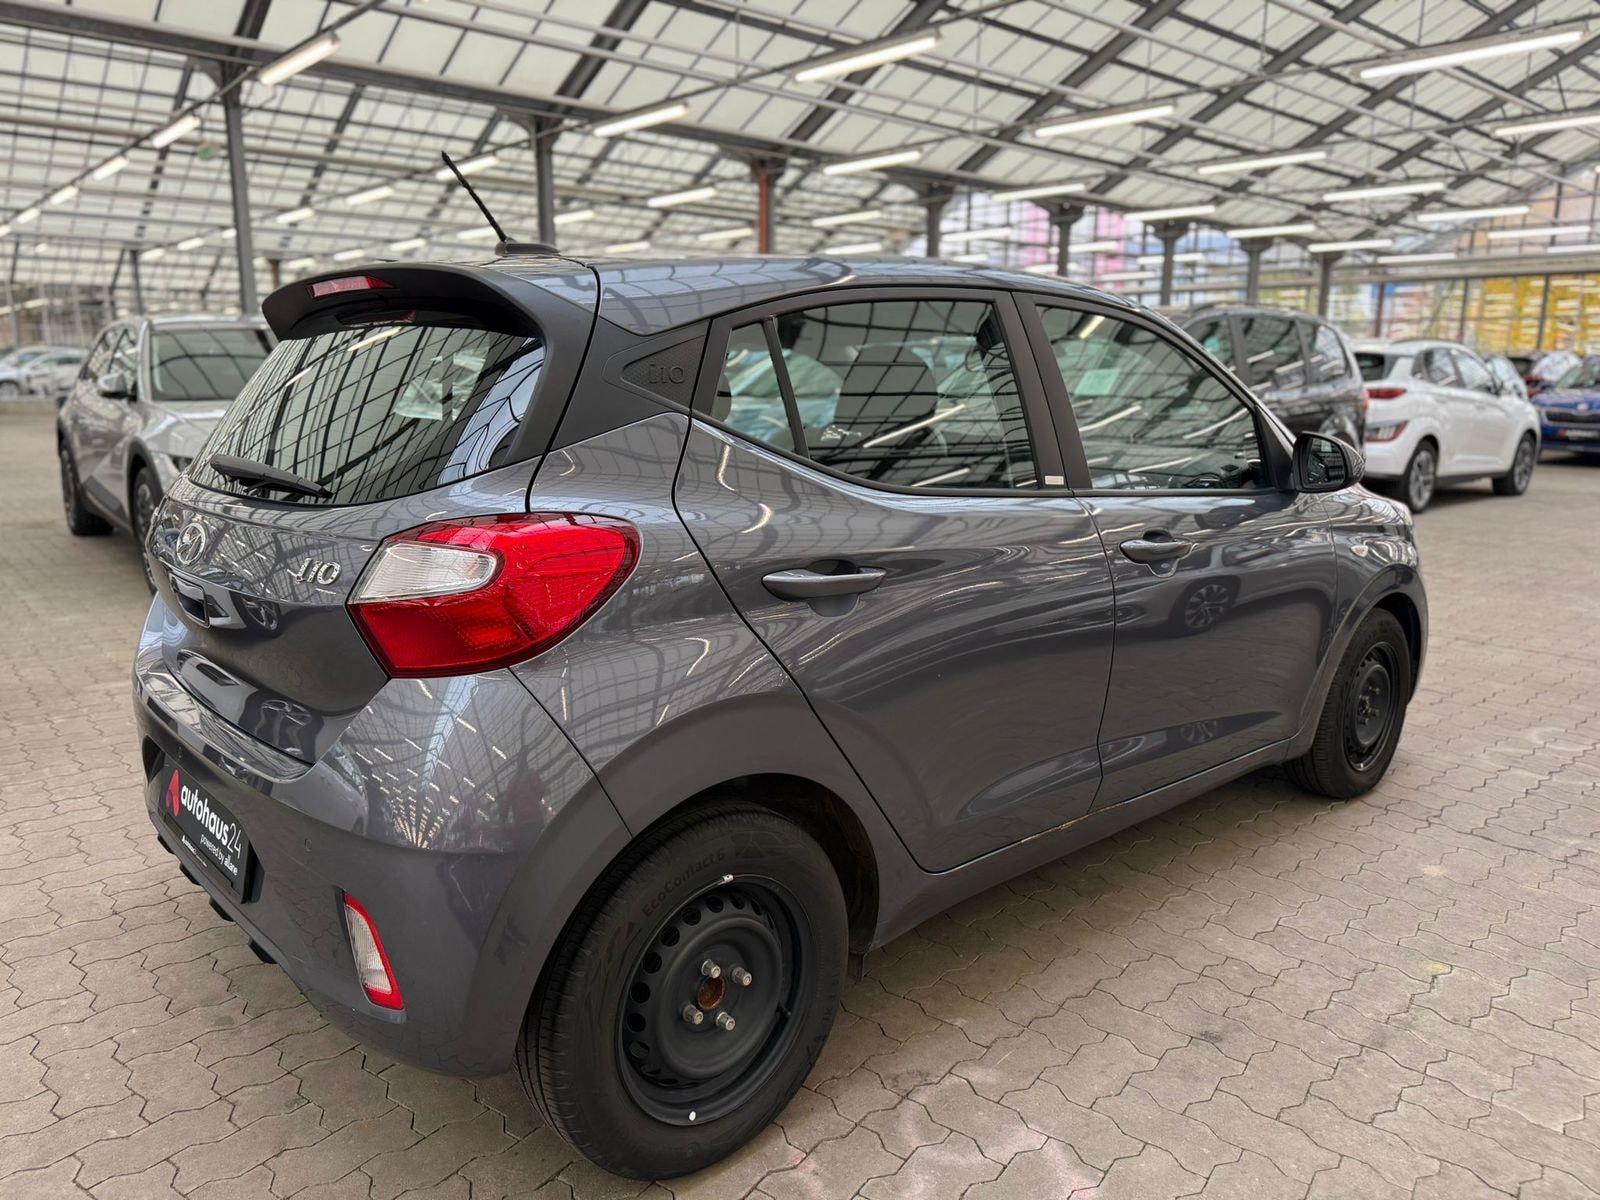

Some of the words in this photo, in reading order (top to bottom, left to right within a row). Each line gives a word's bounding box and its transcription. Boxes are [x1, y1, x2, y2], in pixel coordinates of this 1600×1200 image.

[647, 362, 686, 385] i10
[200, 834, 219, 857] powered
[217, 848, 225, 865] by
